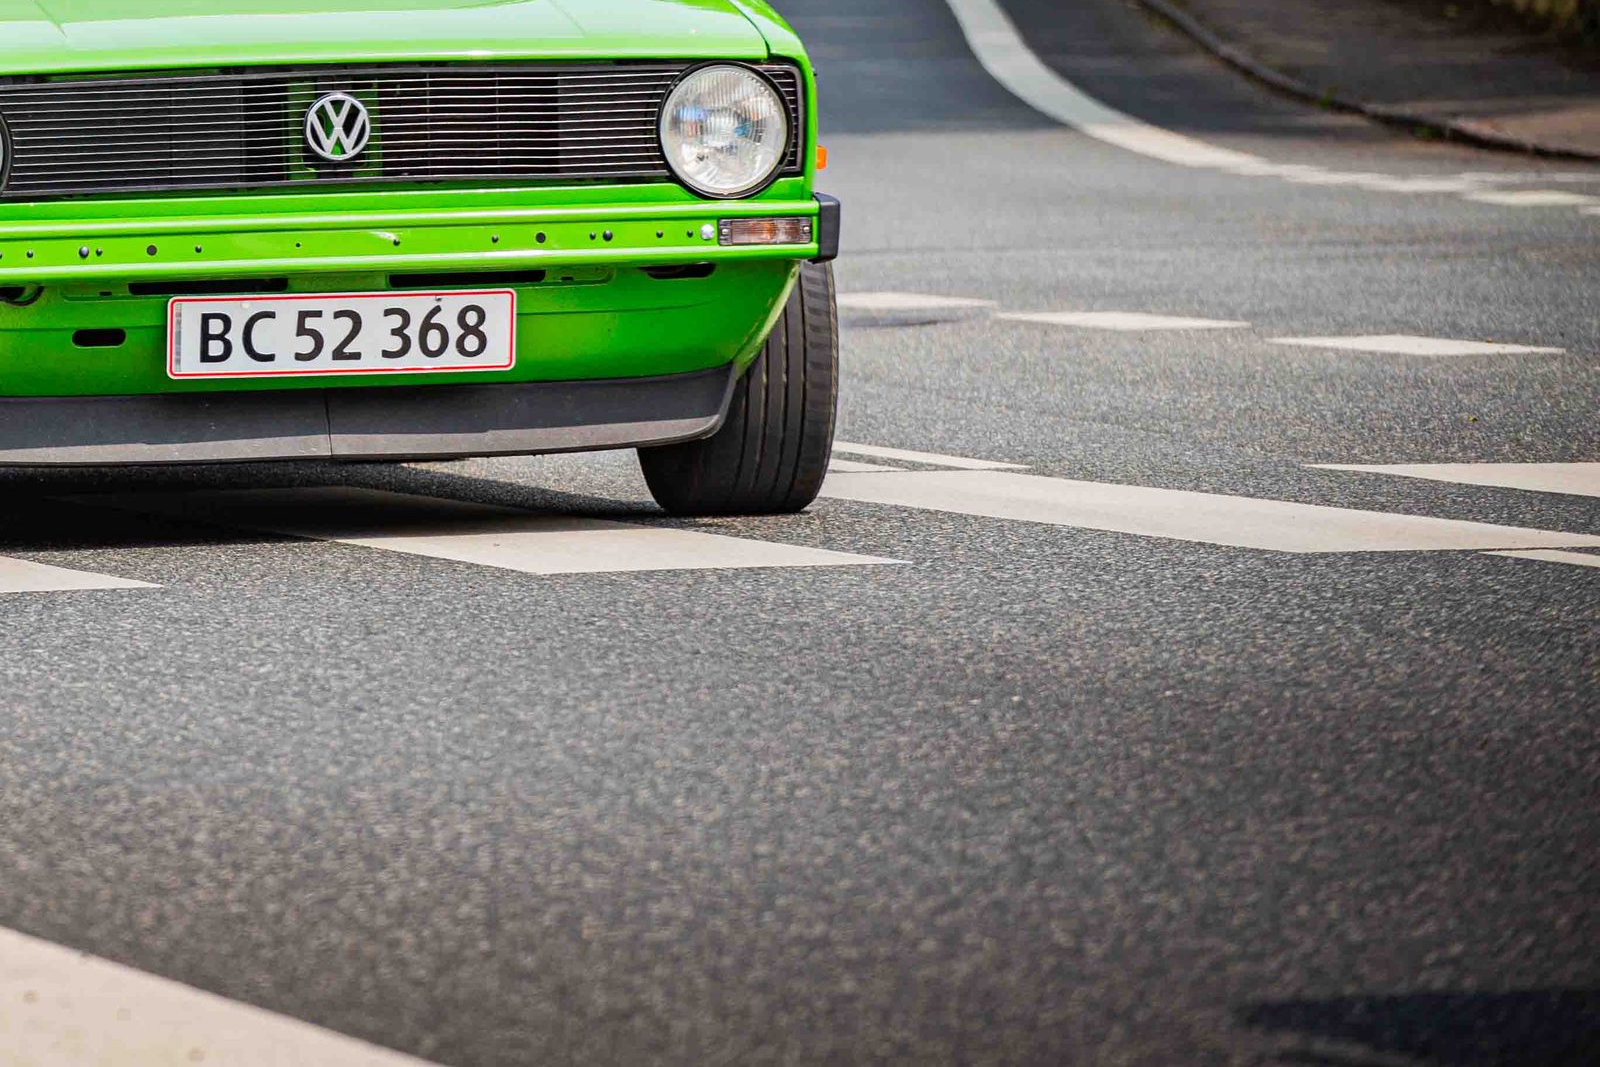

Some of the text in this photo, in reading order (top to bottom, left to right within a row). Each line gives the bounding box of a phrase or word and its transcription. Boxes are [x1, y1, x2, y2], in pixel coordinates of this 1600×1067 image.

[307, 95, 368, 158] VW
[199, 304, 488, 364] BC 52 368
